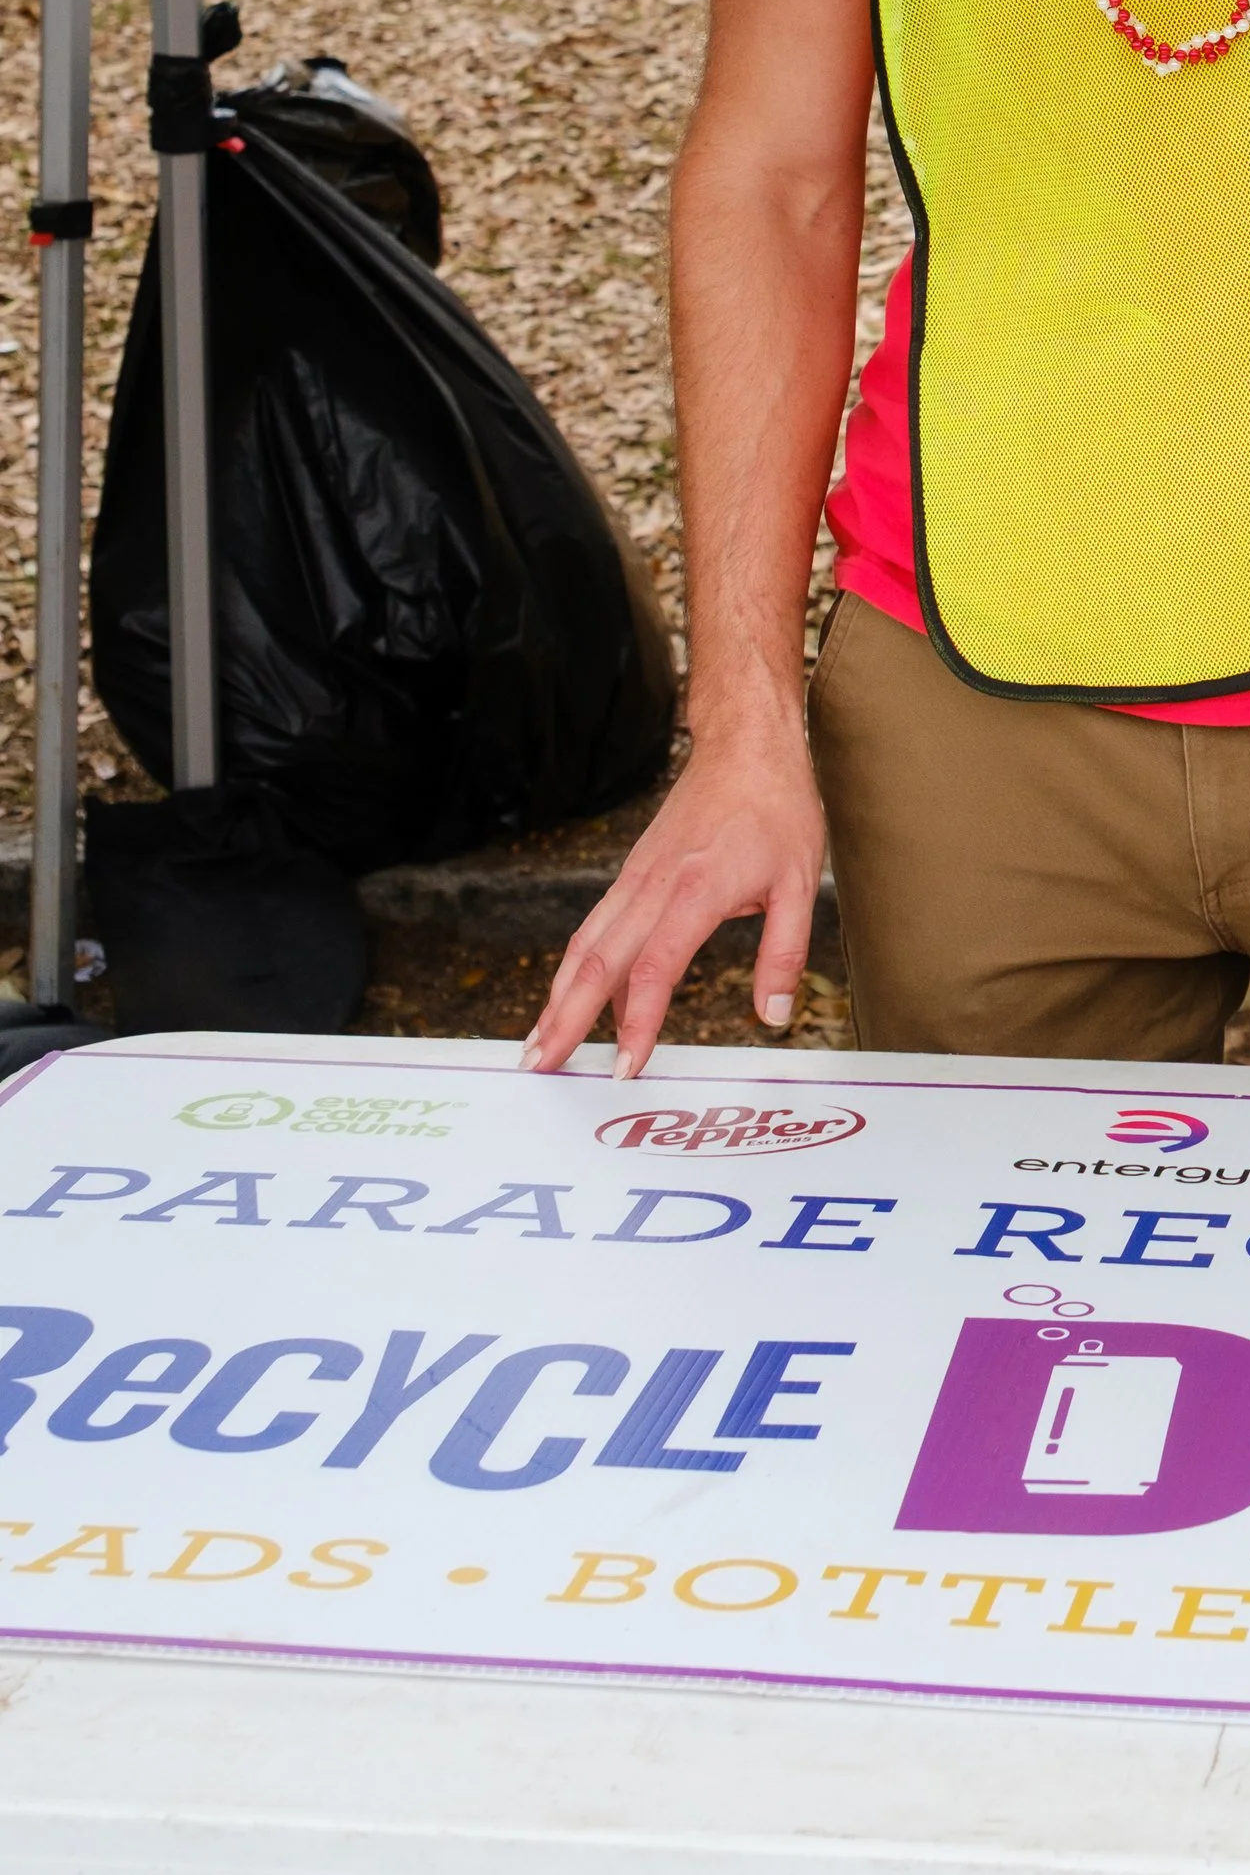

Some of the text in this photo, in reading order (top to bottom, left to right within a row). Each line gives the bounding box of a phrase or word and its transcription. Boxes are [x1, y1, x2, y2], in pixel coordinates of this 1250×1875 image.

[301, 1109, 391, 1123] can
[312, 1096, 452, 1116] every
[698, 1105, 794, 1129] Dr
[289, 1121, 453, 1138] counts
[600, 1110, 848, 1152] Pepper
[1012, 1156, 1250, 1187] entergy
[5, 1164, 899, 1252] PARADE
